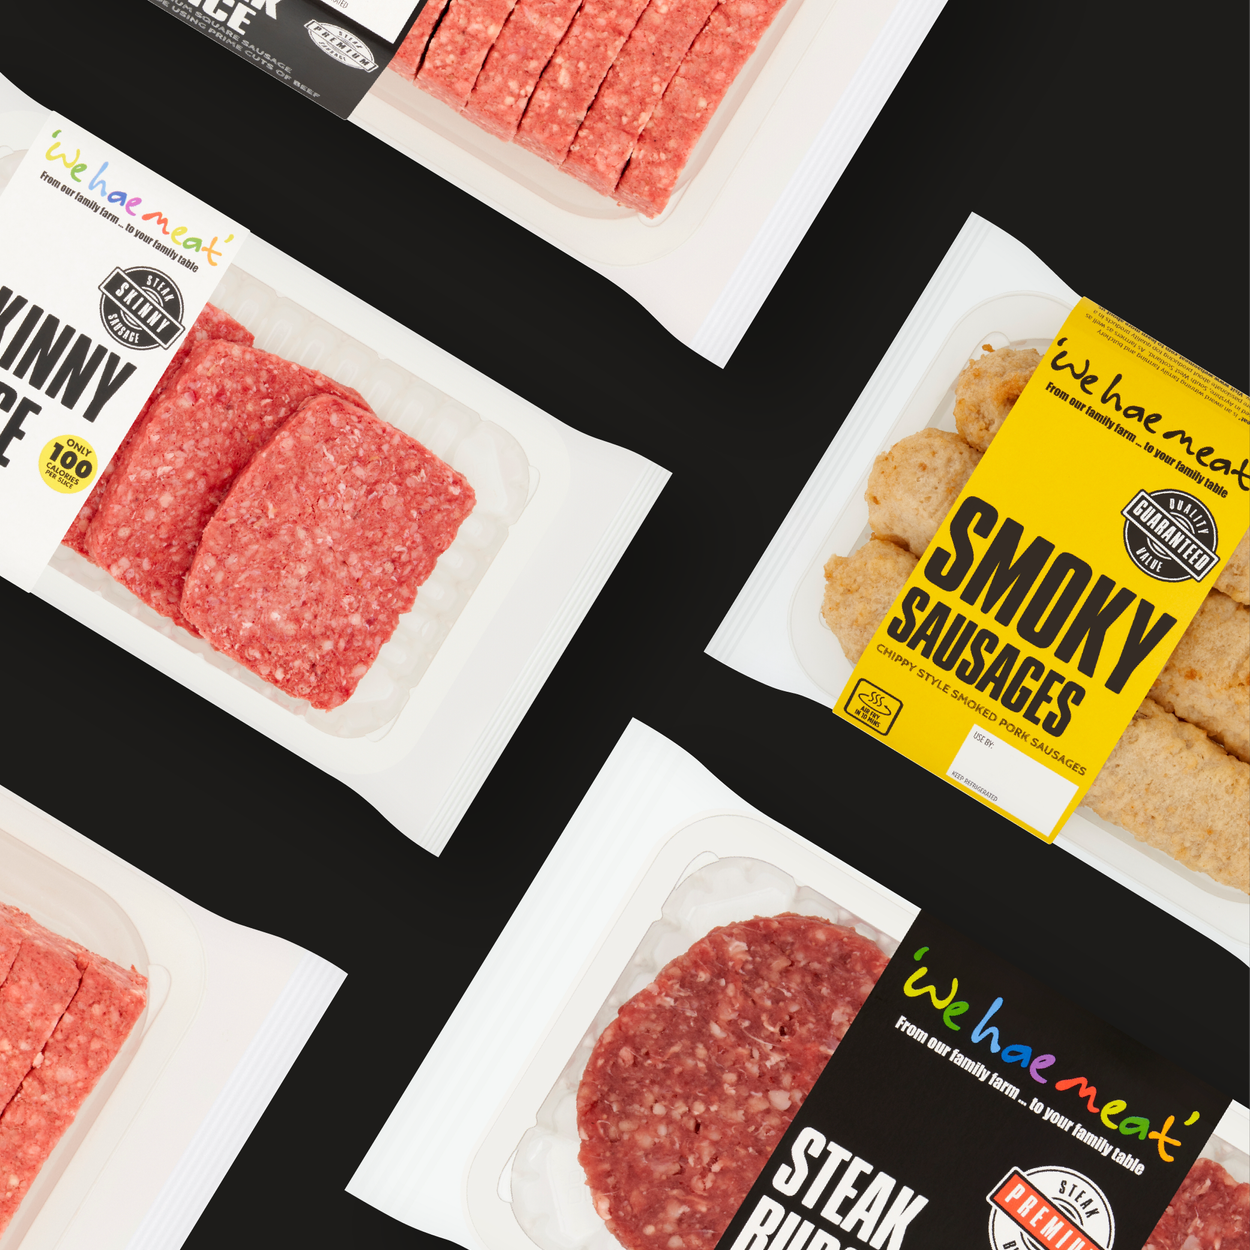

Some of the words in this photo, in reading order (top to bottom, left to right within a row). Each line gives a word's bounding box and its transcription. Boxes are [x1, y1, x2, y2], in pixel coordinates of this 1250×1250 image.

[171, 5, 207, 29] USING
[208, 27, 244, 52] PRIME
[244, 49, 274, 71] CUTS
[275, 69, 292, 80] OF
[292, 79, 321, 98] BEEF
[194, 11, 241, 42] SQUARE
[241, 39, 291, 74] SAUSAGE
[313, 26, 370, 66] PREMIUM
[88, 161, 143, 217] hae
[40, 170, 62, 189] From
[60, 184, 76, 197] our
[74, 191, 101, 213] family
[99, 206, 120, 225] farm
[124, 223, 135, 234] to
[133, 229, 154, 245] your
[152, 239, 179, 261] family
[177, 255, 199, 273] table
[115, 281, 171, 333] SKINNY
[146, 275, 175, 302] STEAK
[107, 313, 140, 344] SAUSAGE
[1100, 373, 1163, 435] hae
[49, 441, 93, 479] 100
[66, 438, 92, 457] ONLY
[44, 469, 57, 480] PER
[57, 476, 74, 490] SLICE
[46, 461, 80, 486] CALORIES
[1132, 499, 1210, 571] GUARANTEED
[1169, 497, 1209, 534] QUALITY
[1135, 546, 1163, 573] VALUE
[923, 495, 1178, 695] SMOKY
[886, 586, 1086, 738] SAUSAGES
[970, 996, 1056, 1084] hae
[1058, 1179, 1100, 1219] STEAK
